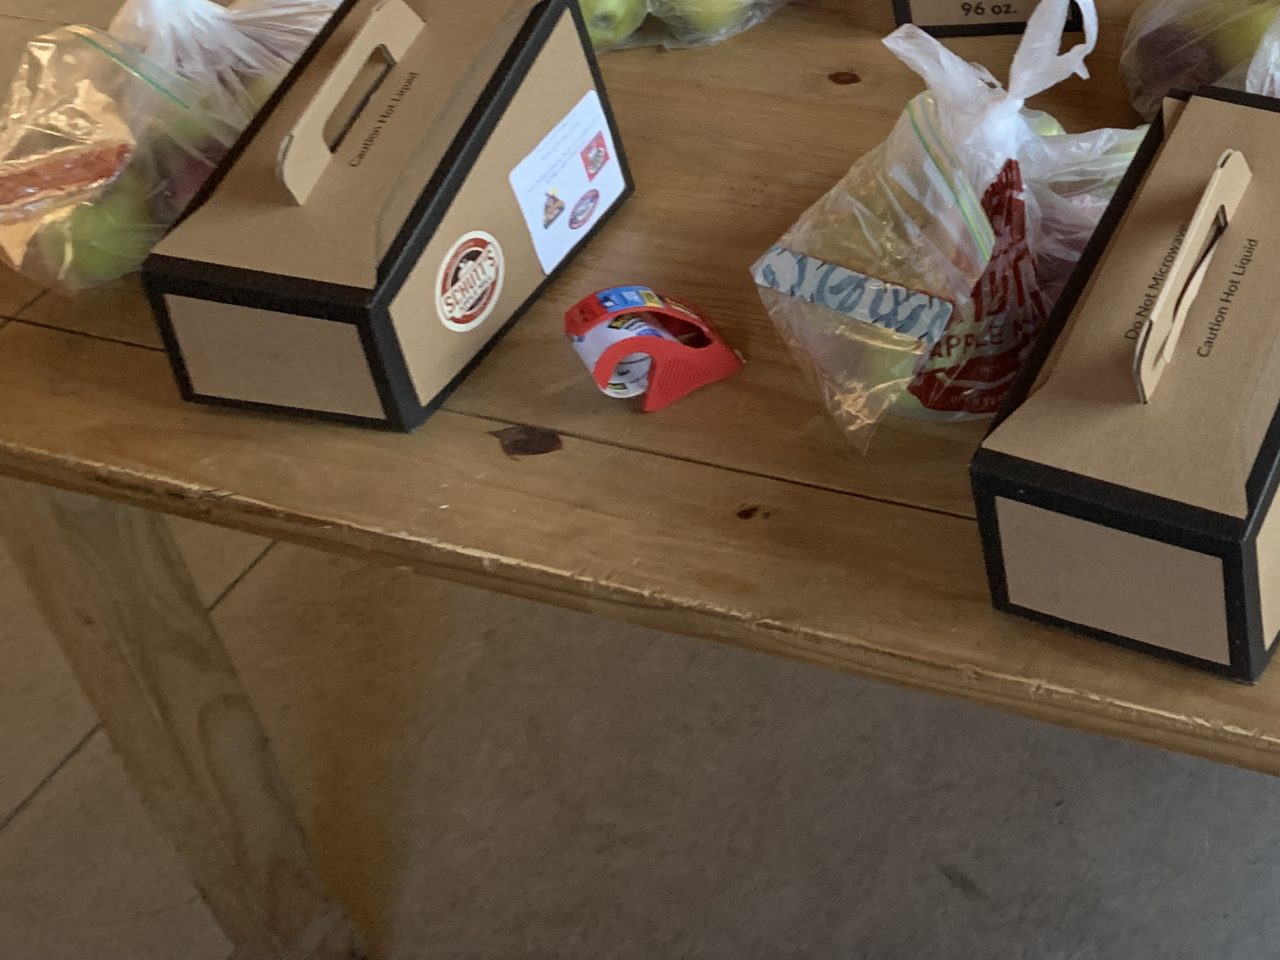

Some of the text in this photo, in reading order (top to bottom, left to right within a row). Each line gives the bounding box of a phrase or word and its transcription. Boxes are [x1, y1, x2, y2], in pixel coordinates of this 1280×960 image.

[960, 1, 1018, 17] 96 oz.
[348, 71, 419, 167] Caution Hot Liquid
[1124, 320, 1141, 341] Do
[1135, 294, 1156, 318] Not
[1196, 238, 1258, 358] Caution Hot Liquid
